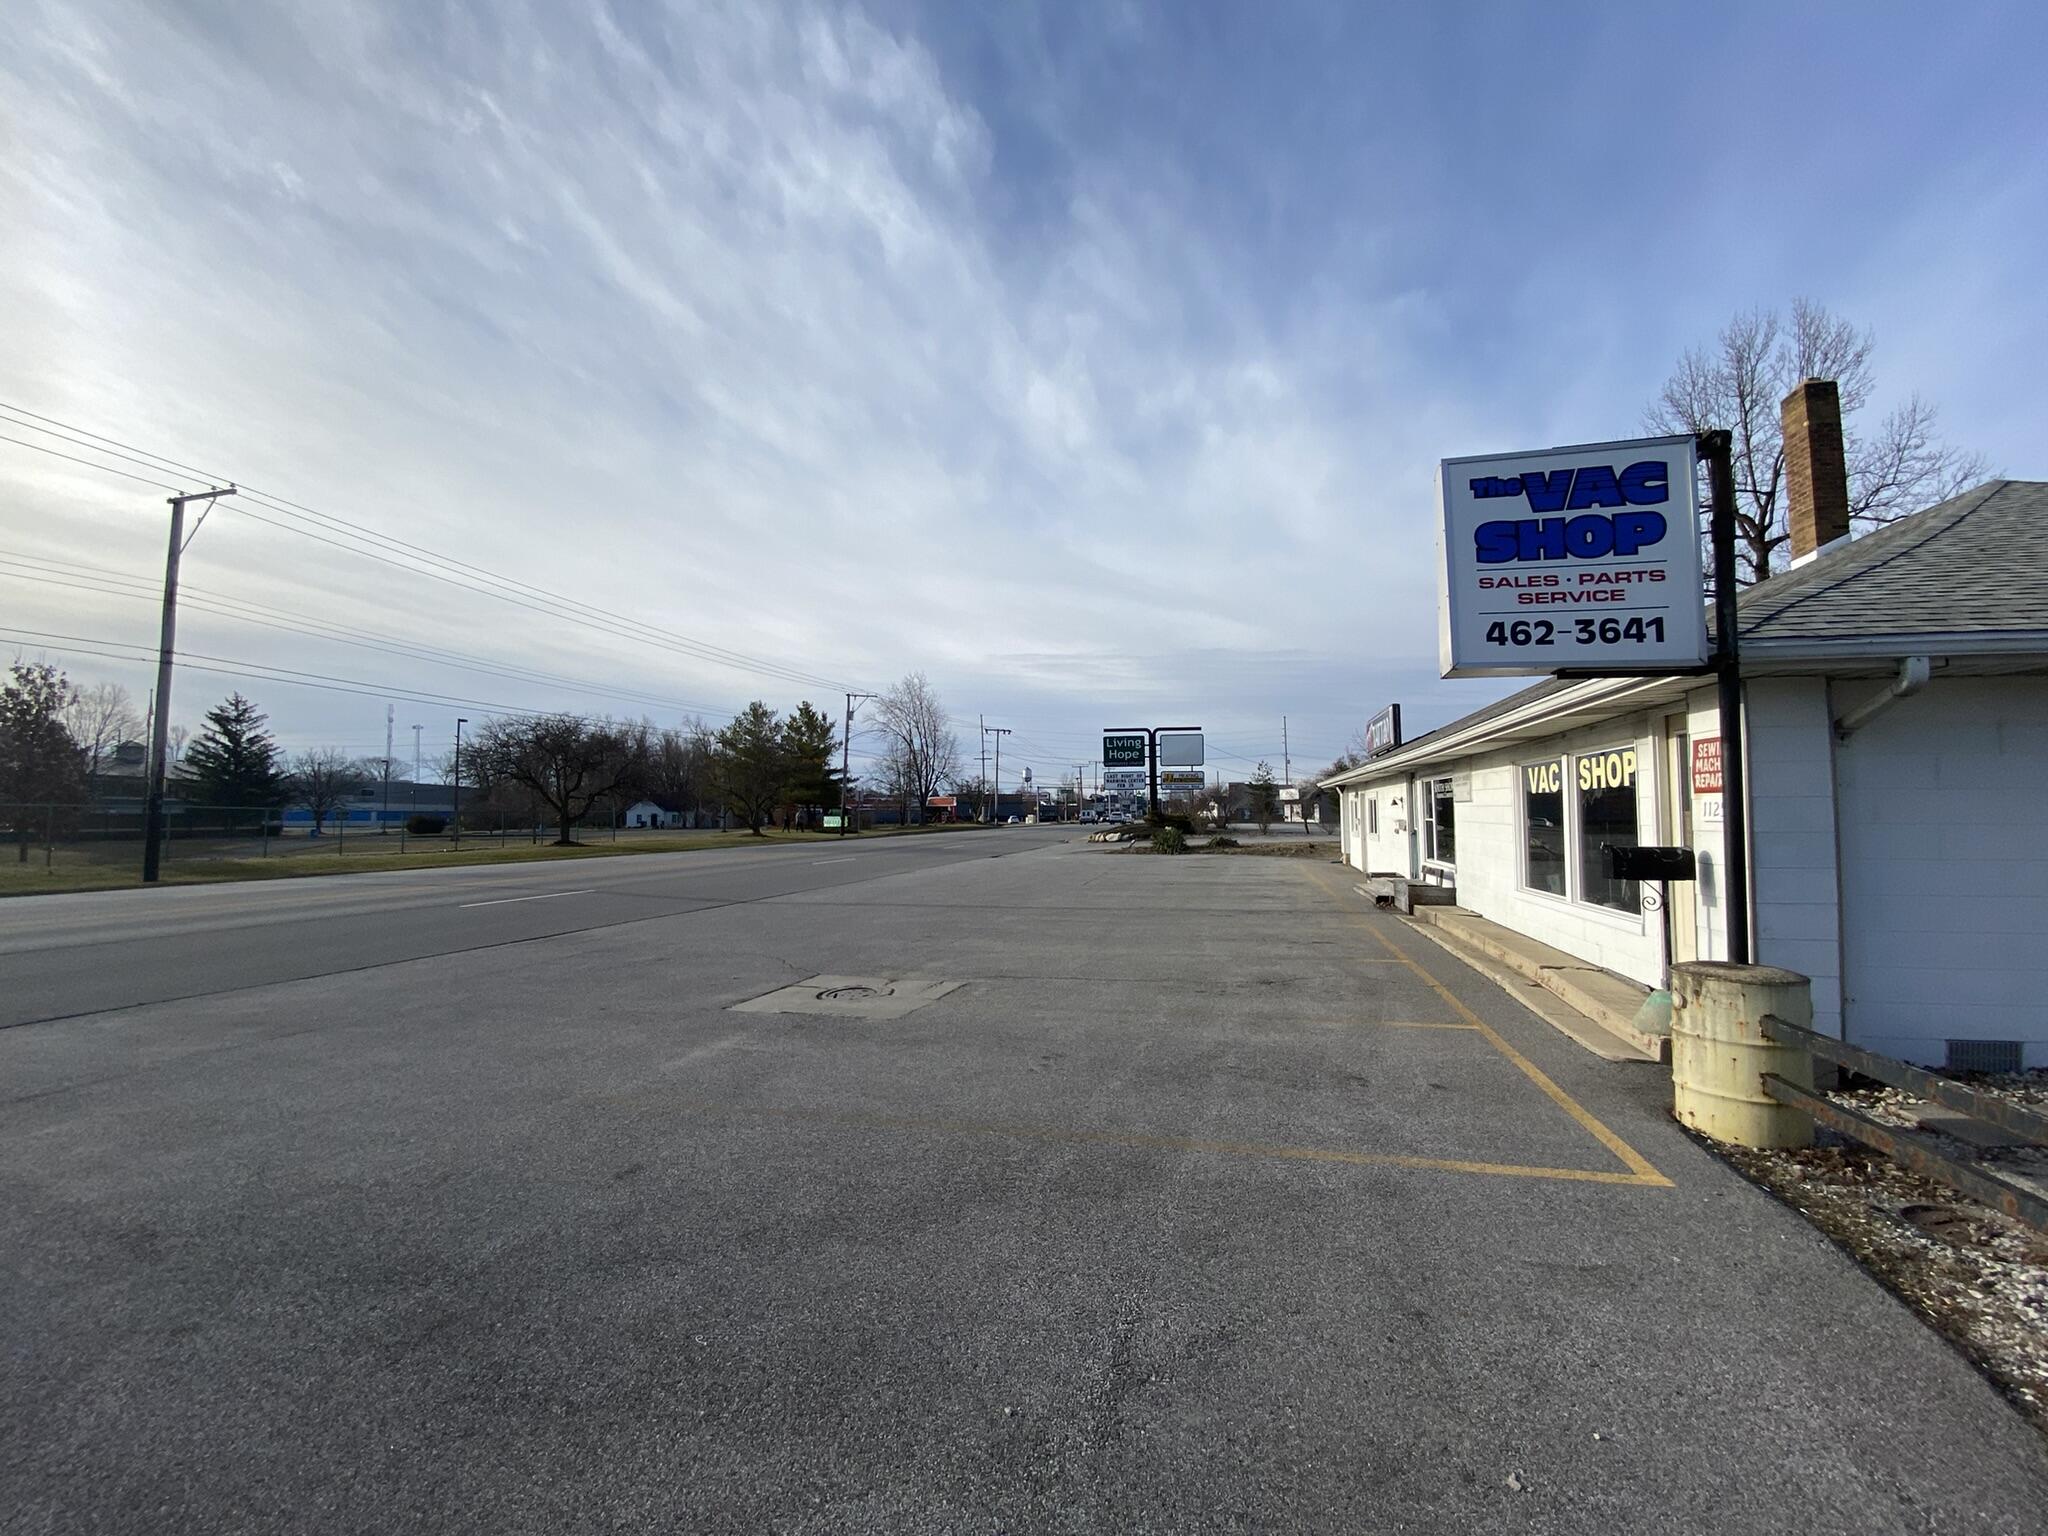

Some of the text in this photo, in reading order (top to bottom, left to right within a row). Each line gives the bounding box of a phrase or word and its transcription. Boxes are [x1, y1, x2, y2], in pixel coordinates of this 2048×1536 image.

[1469, 461, 1669, 513] The VAC
[1474, 511, 1667, 563] SHOP
[1479, 570, 1666, 589] SALES PARTS
[1517, 589, 1626, 604] SERVICE
[1486, 617, 1665, 646] 462-3641
[1106, 738, 1142, 749] Living
[1697, 741, 1720, 757] SEWI
[1109, 749, 1140, 761] Hope
[1528, 751, 1636, 794] VAC SHOP
[1695, 757, 1721, 773] MACH
[1703, 801, 1724, 817] 112
